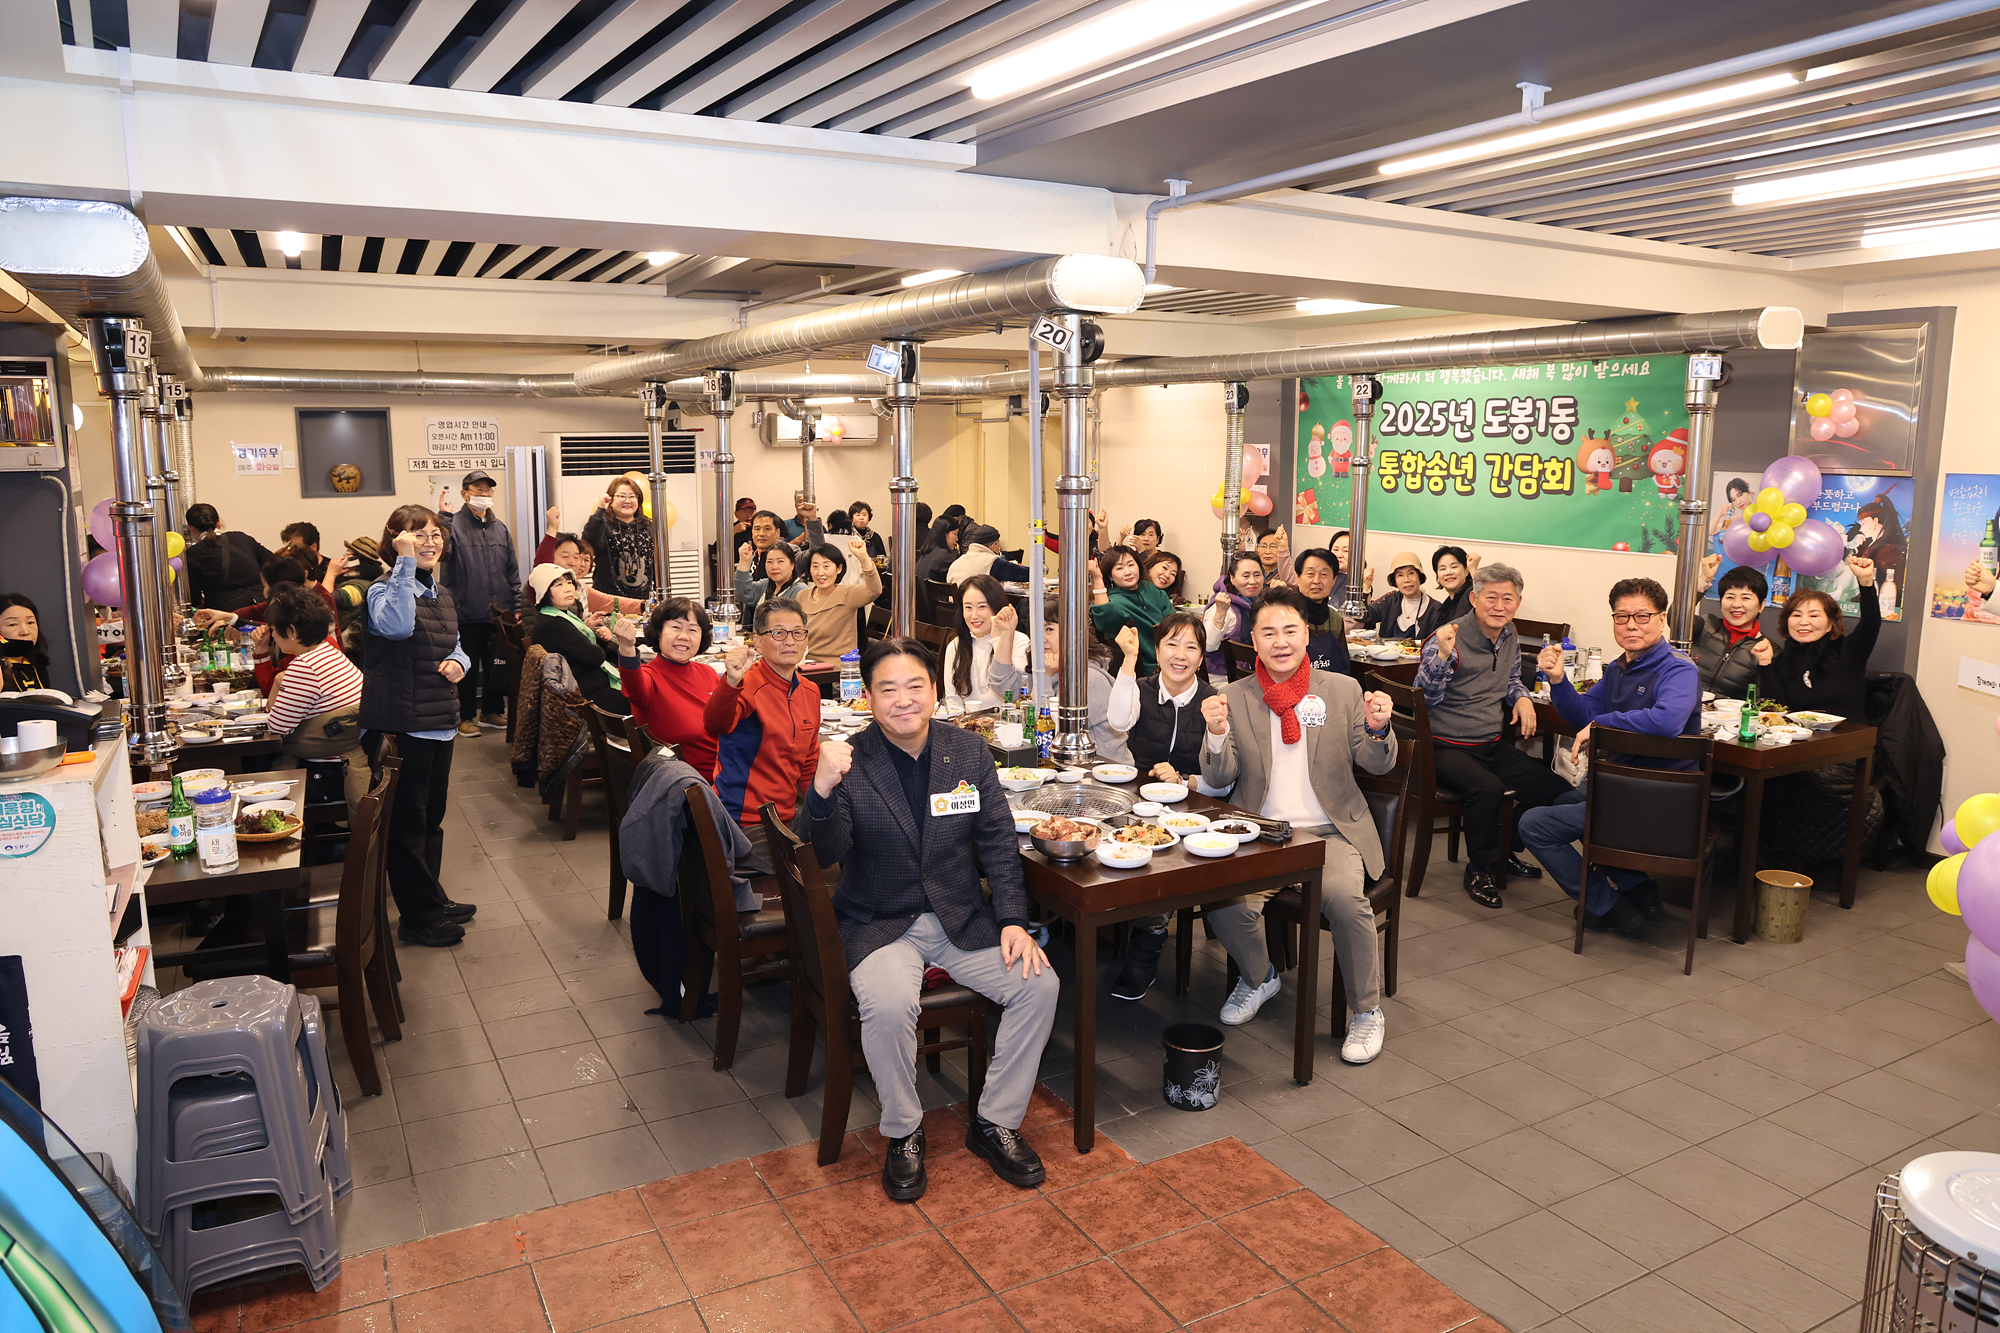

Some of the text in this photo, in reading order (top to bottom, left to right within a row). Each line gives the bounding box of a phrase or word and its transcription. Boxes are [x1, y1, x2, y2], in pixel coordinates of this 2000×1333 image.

[1038, 323, 1067, 345] 20
[130, 335, 147, 355] 13
[1425, 372, 1435, 384] 더
[1512, 366, 1539, 381] 새해
[1545, 363, 1556, 381] 복
[1562, 363, 1588, 381] 많이
[1593, 361, 1650, 379] 받으세요
[1694, 361, 1714, 376] 21
[167, 385, 182, 396] 15
[706, 380, 717, 391] 18
[1356, 385, 1369, 396] 22
[641, 390, 654, 400] 17
[1226, 390, 1234, 400] 23
[438, 421, 487, 429] 영업시간 안내
[1380, 396, 1577, 443] 2025년 도봉1동
[432, 432, 495, 441] 오픈시간 Am 11:00
[432, 443, 496, 451] 마감시간 Pm 10:00
[256, 463, 279, 471] 화요일
[413, 460, 428, 469] 저희
[432, 459, 456, 468] 업소는
[459, 459, 471, 468] 1인
[475, 459, 487, 468] 1식
[1378, 450, 1573, 498] 통합송년 간담회
[1812, 501, 1861, 513] 부드럽구나
[1952, 501, 1986, 516] 부드러운
[844, 688, 860, 697] KRUSH
[0, 800, 34, 815] 울형
[180, 829, 192, 837] 이슬
[211, 838, 220, 847] 새
